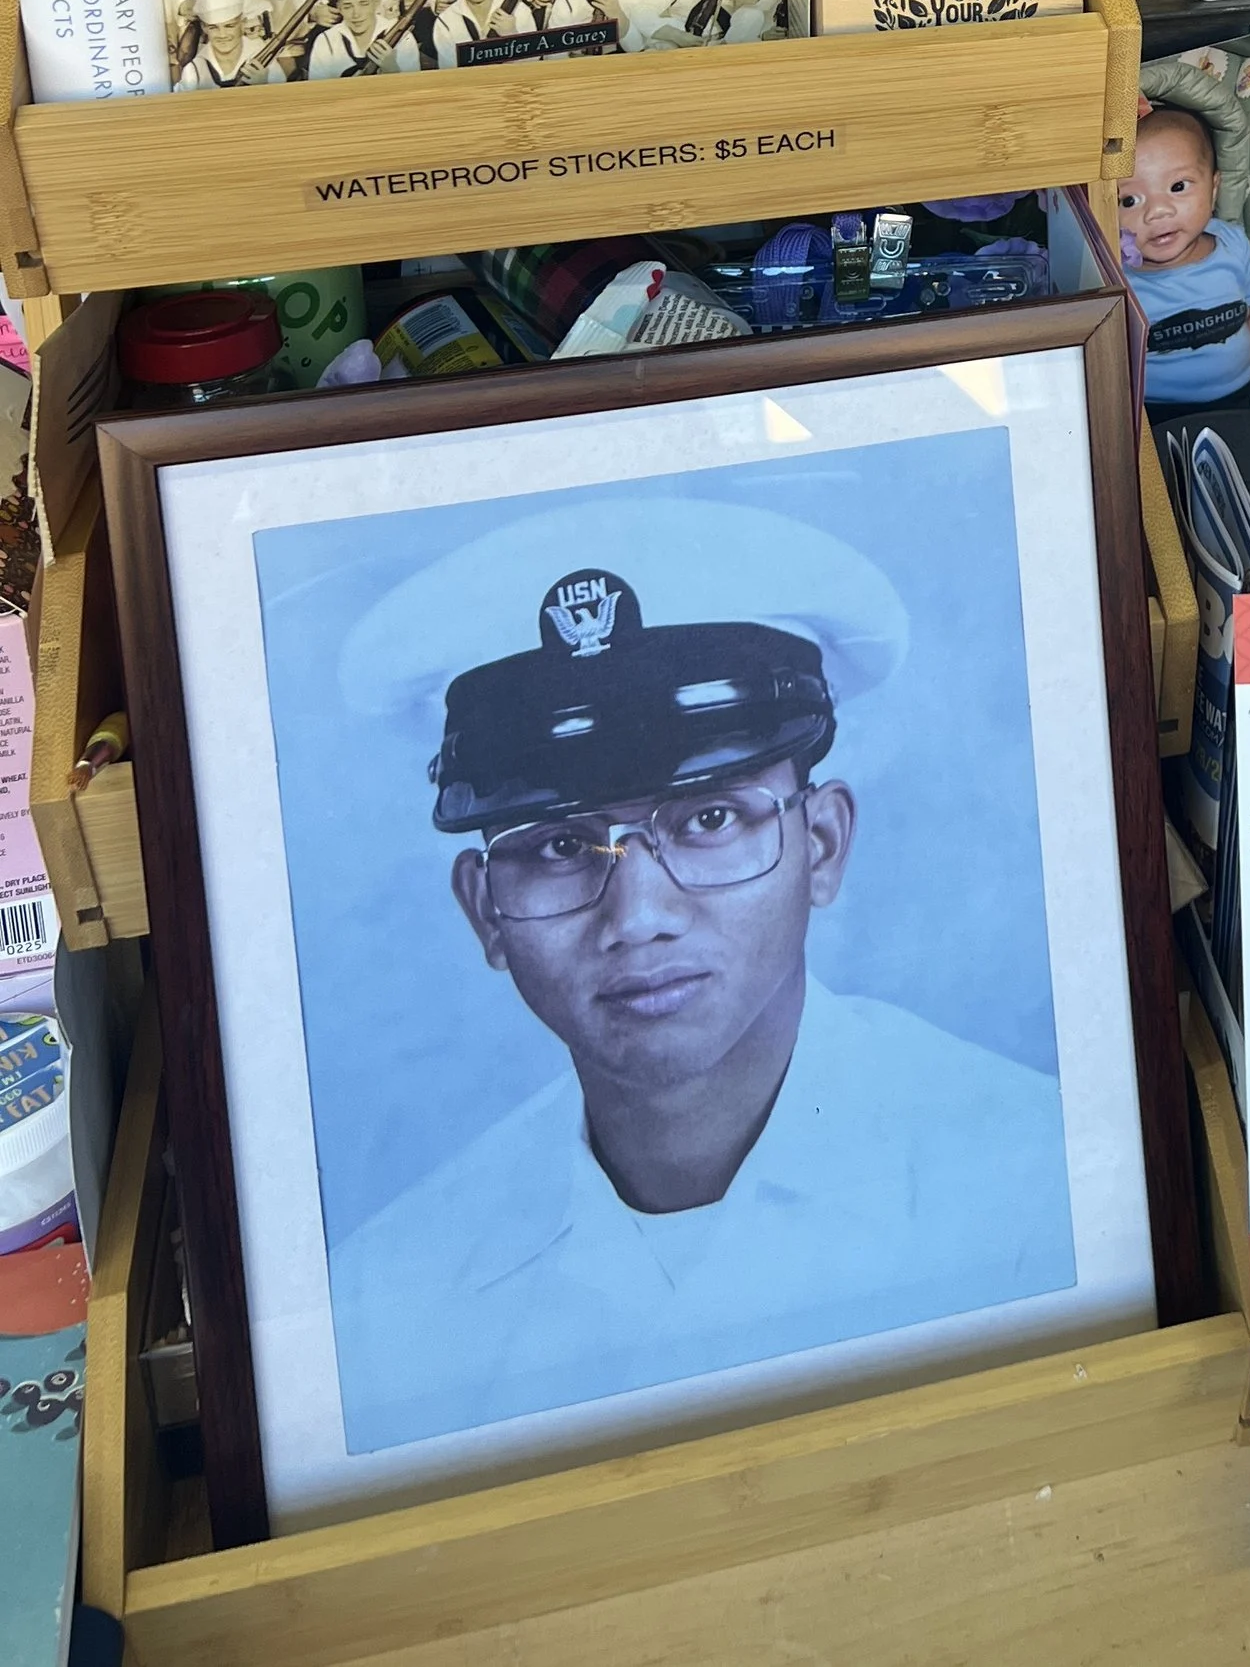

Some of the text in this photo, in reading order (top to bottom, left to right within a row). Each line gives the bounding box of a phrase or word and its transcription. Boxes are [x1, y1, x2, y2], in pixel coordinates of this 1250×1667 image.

[467, 27, 607, 63] Jennifer A. Garey
[315, 130, 835, 202] WATERPROOF STICKERS: $5 EACH
[1153, 304, 1246, 340] STRONGHOLD
[557, 577, 607, 608] USN
[5, 873, 46, 888] DRY PLACE
[7, 941, 42, 955] 0225
